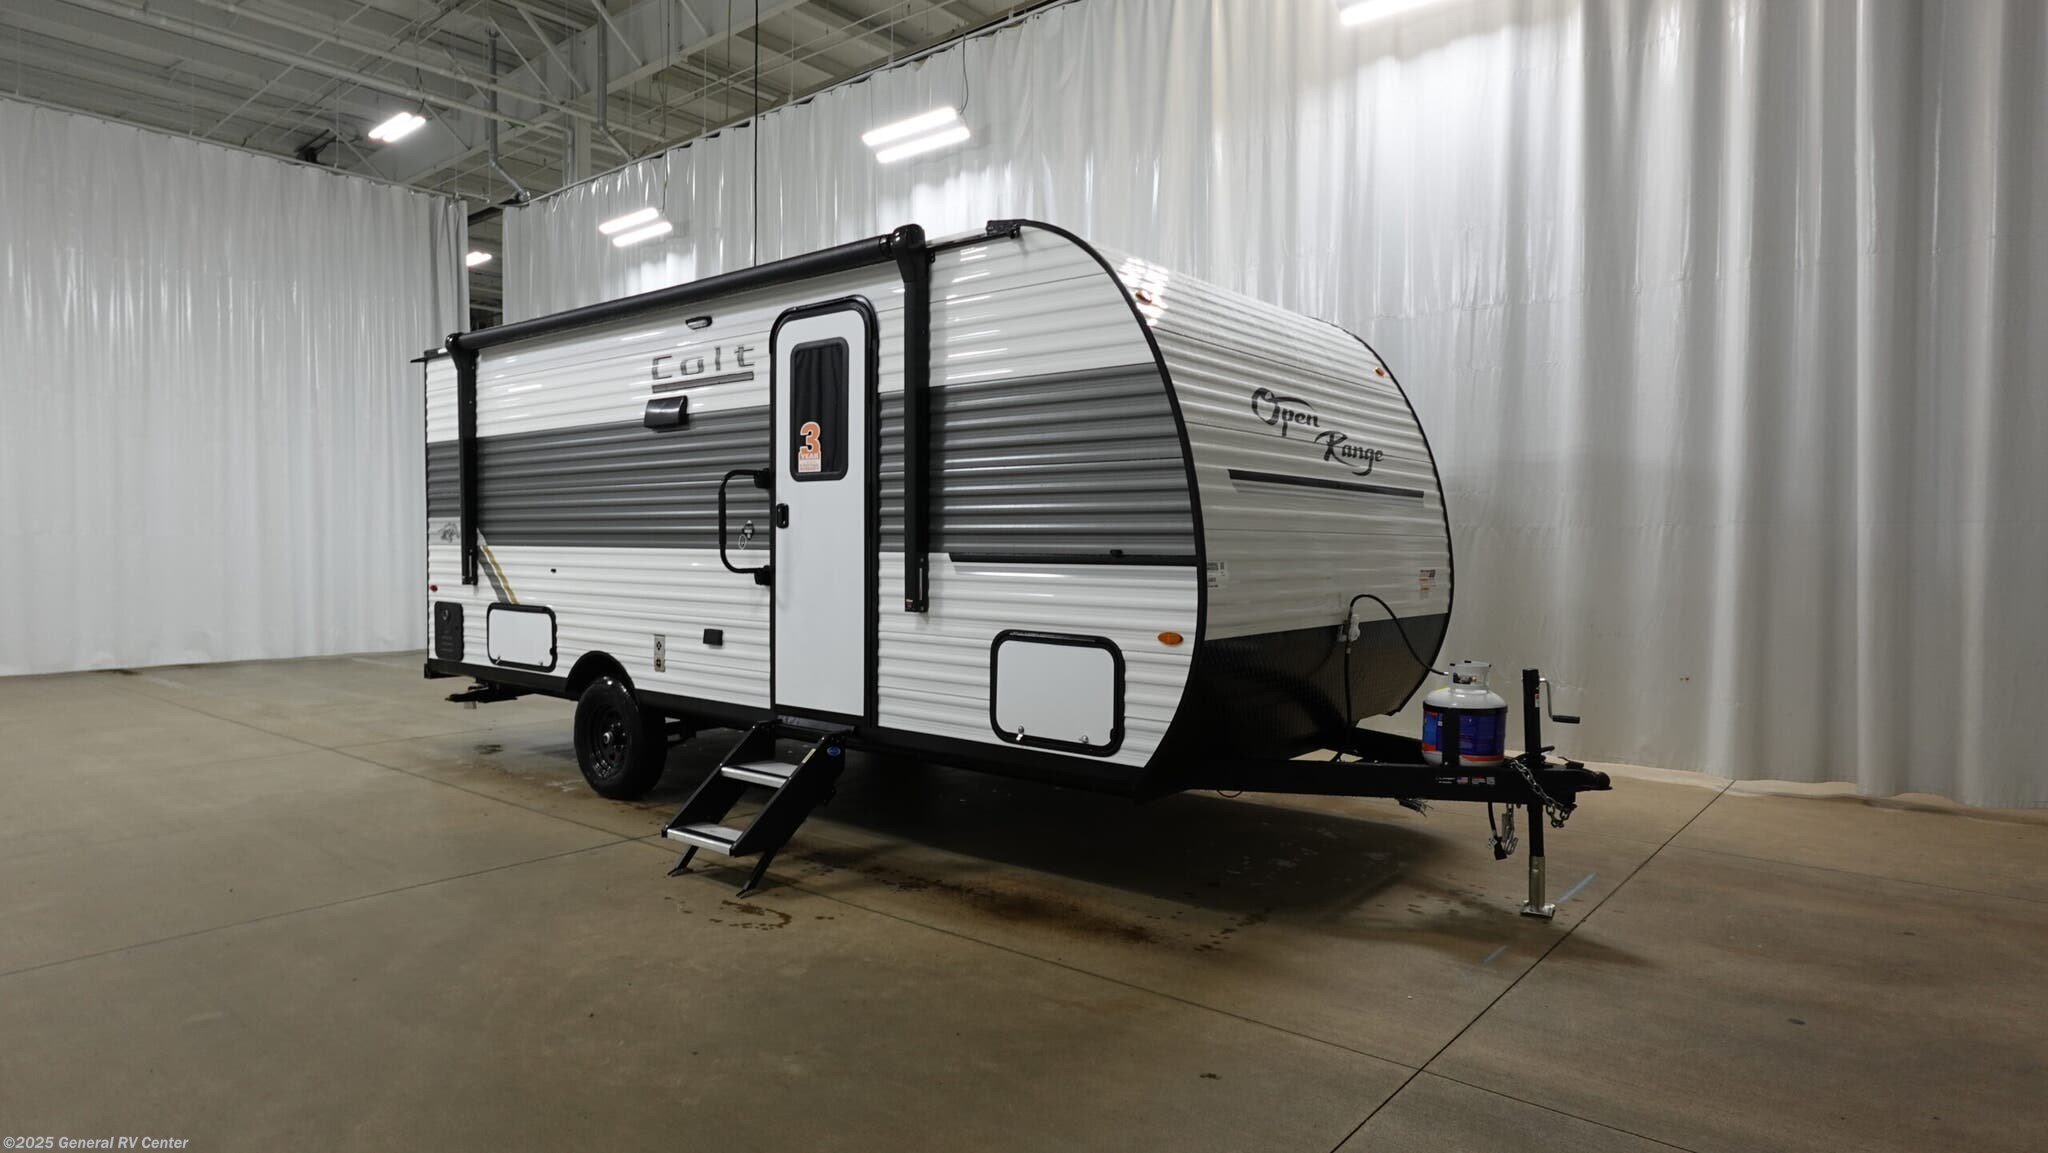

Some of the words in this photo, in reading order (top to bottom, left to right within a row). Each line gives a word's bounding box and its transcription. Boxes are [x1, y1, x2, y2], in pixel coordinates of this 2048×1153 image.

[651, 345, 755, 380] Colt
[1251, 387, 1320, 438] Open
[800, 421, 821, 454] 3
[1314, 430, 1385, 477] Range
[799, 452, 820, 461] YEAR
